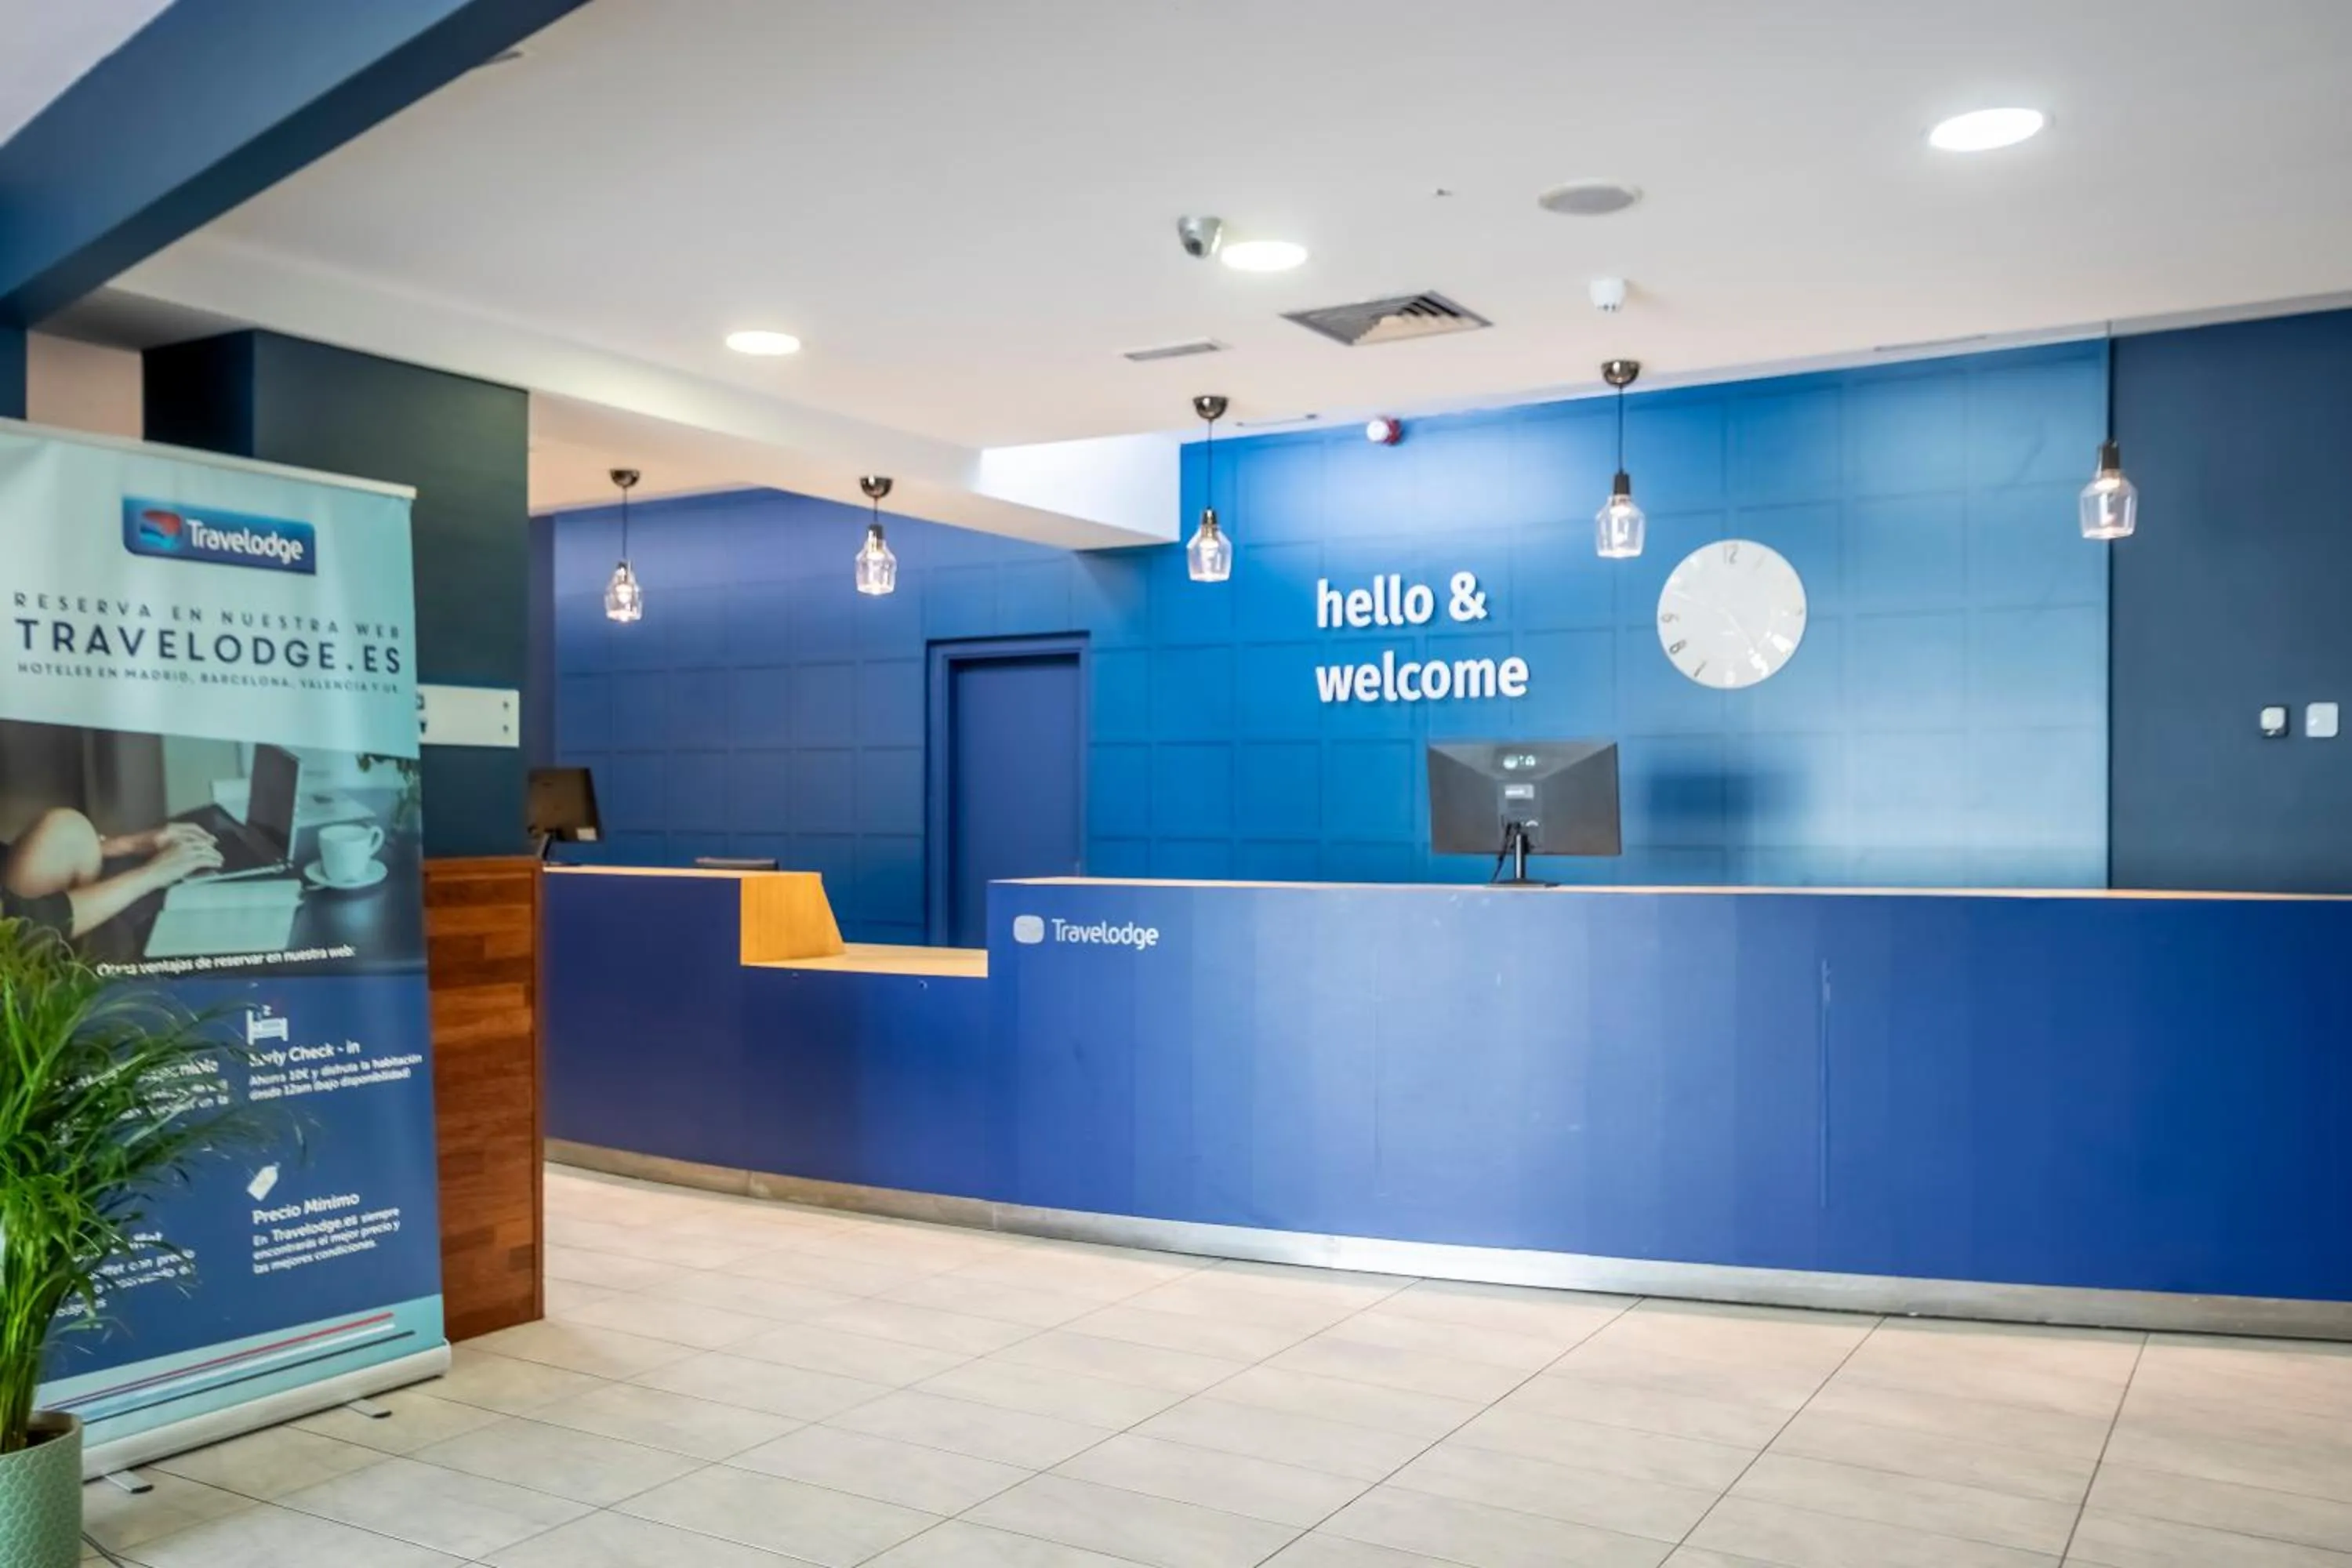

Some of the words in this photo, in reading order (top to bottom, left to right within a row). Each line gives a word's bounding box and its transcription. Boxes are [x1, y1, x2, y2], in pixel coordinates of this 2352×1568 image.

[185, 517, 304, 565] Travelodge
[13, 592, 152, 618] RESERVA
[172, 605, 202, 622] EN
[220, 608, 339, 633] NUESTRA
[353, 622, 400, 640] WEB
[1317, 573, 1435, 629] hello
[1449, 571, 1488, 622] &
[14, 618, 401, 674] TRAVELODGE.ES
[1316, 650, 1530, 703] welcome
[1051, 918, 1160, 950] Travelodge
[289, 1041, 335, 1062] Check
[252, 1203, 302, 1225] Precio
